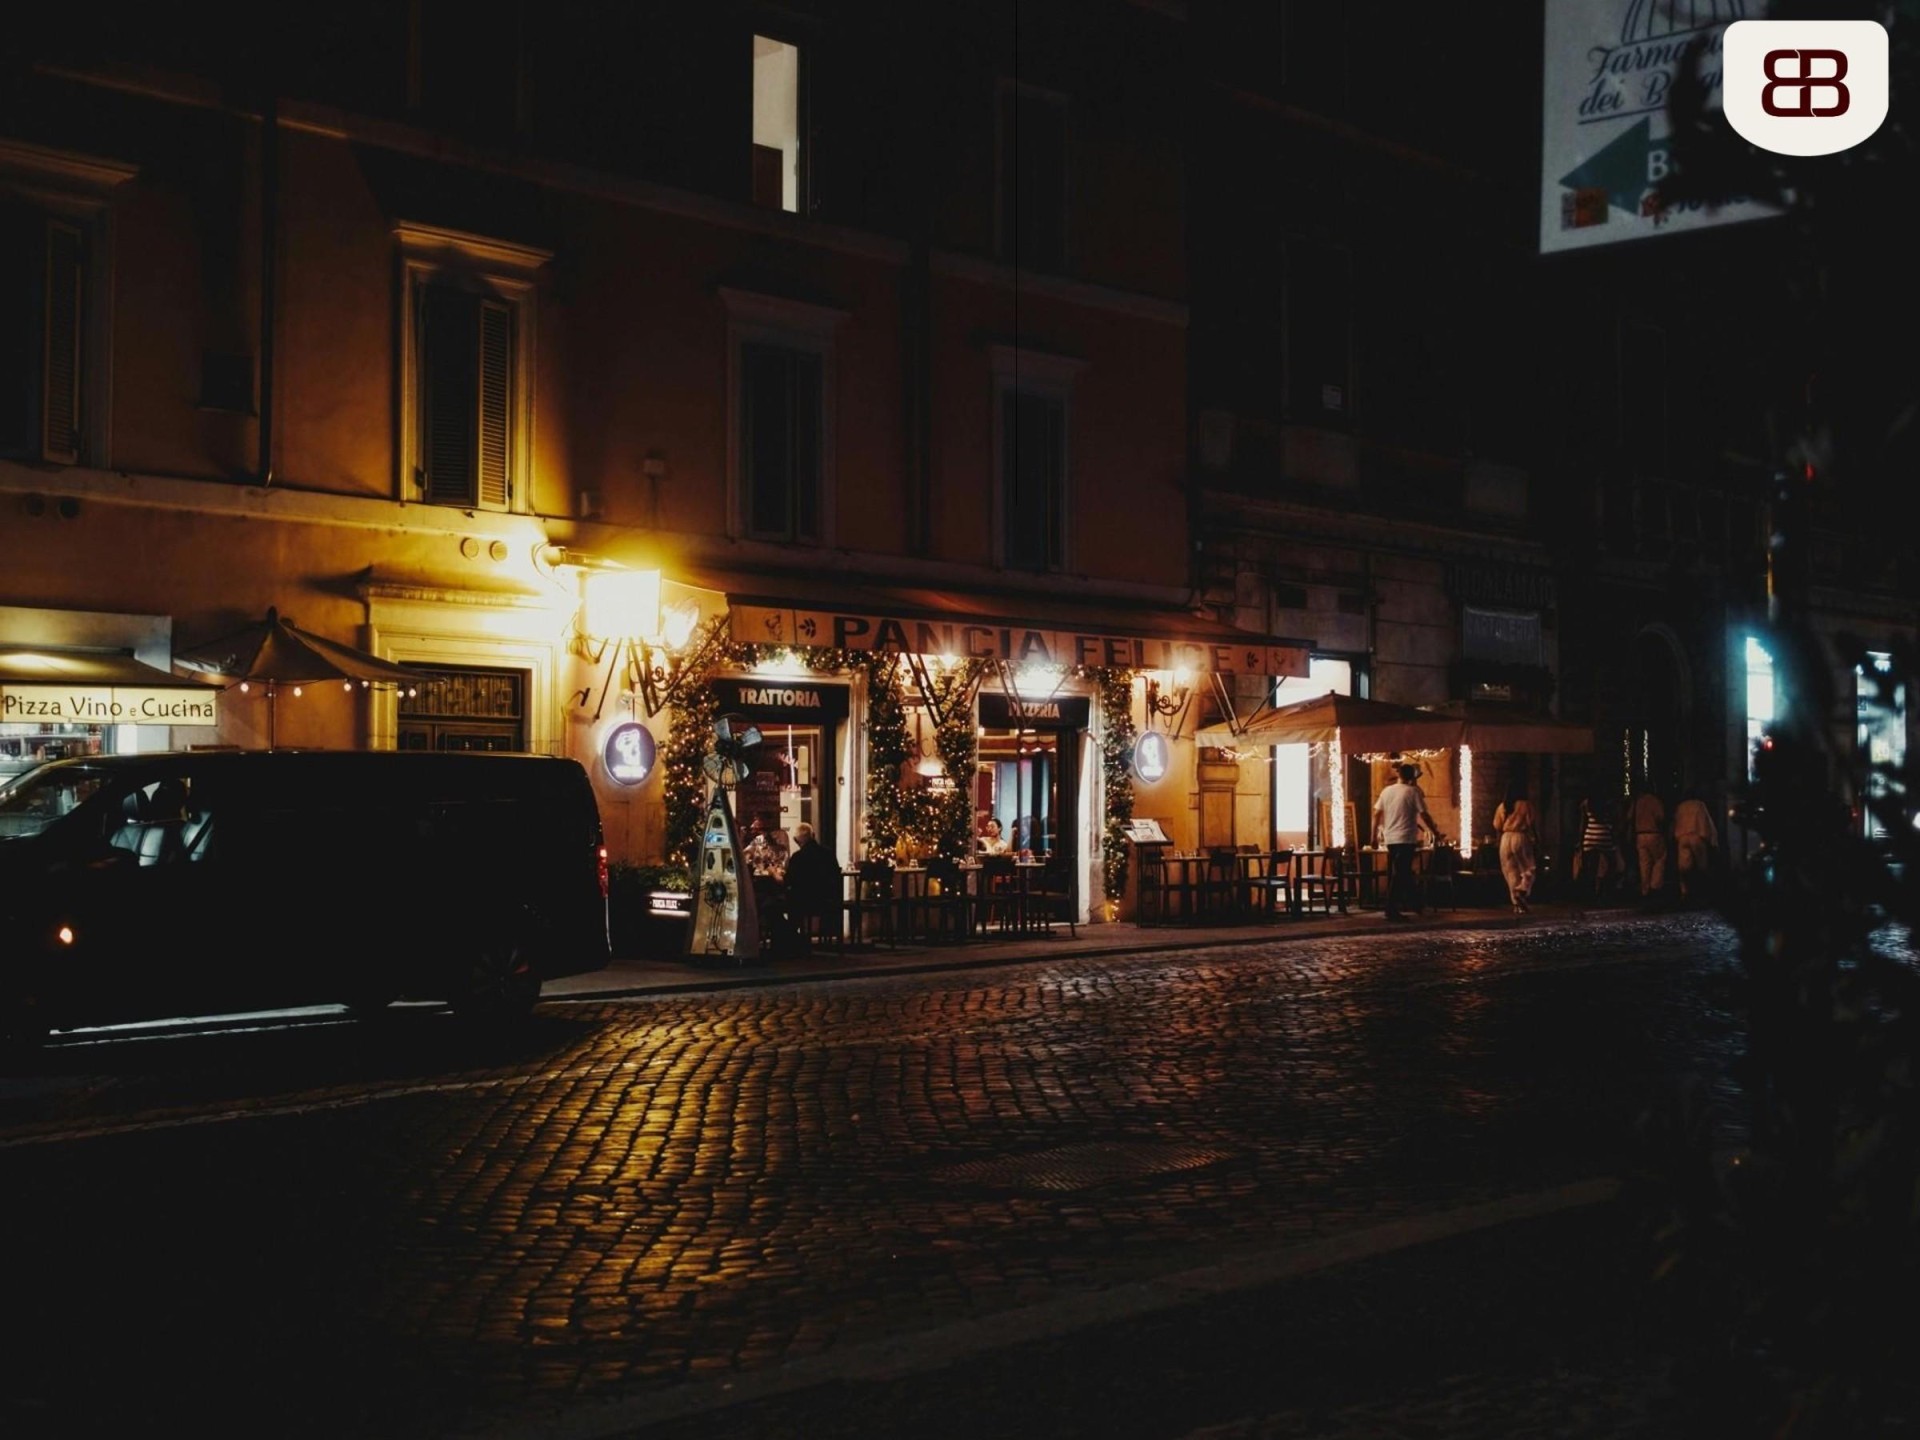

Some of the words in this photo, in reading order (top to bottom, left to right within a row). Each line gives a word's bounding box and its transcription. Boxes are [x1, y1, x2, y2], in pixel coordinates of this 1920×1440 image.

[1579, 78, 1624, 116] dei
[833, 616, 1051, 661] PANCIA
[5, 695, 62, 716] Pizza
[70, 696, 123, 717] Vino
[129, 706, 137, 717] e
[141, 698, 214, 717] Cucina
[738, 687, 822, 708] TRATTORIA
